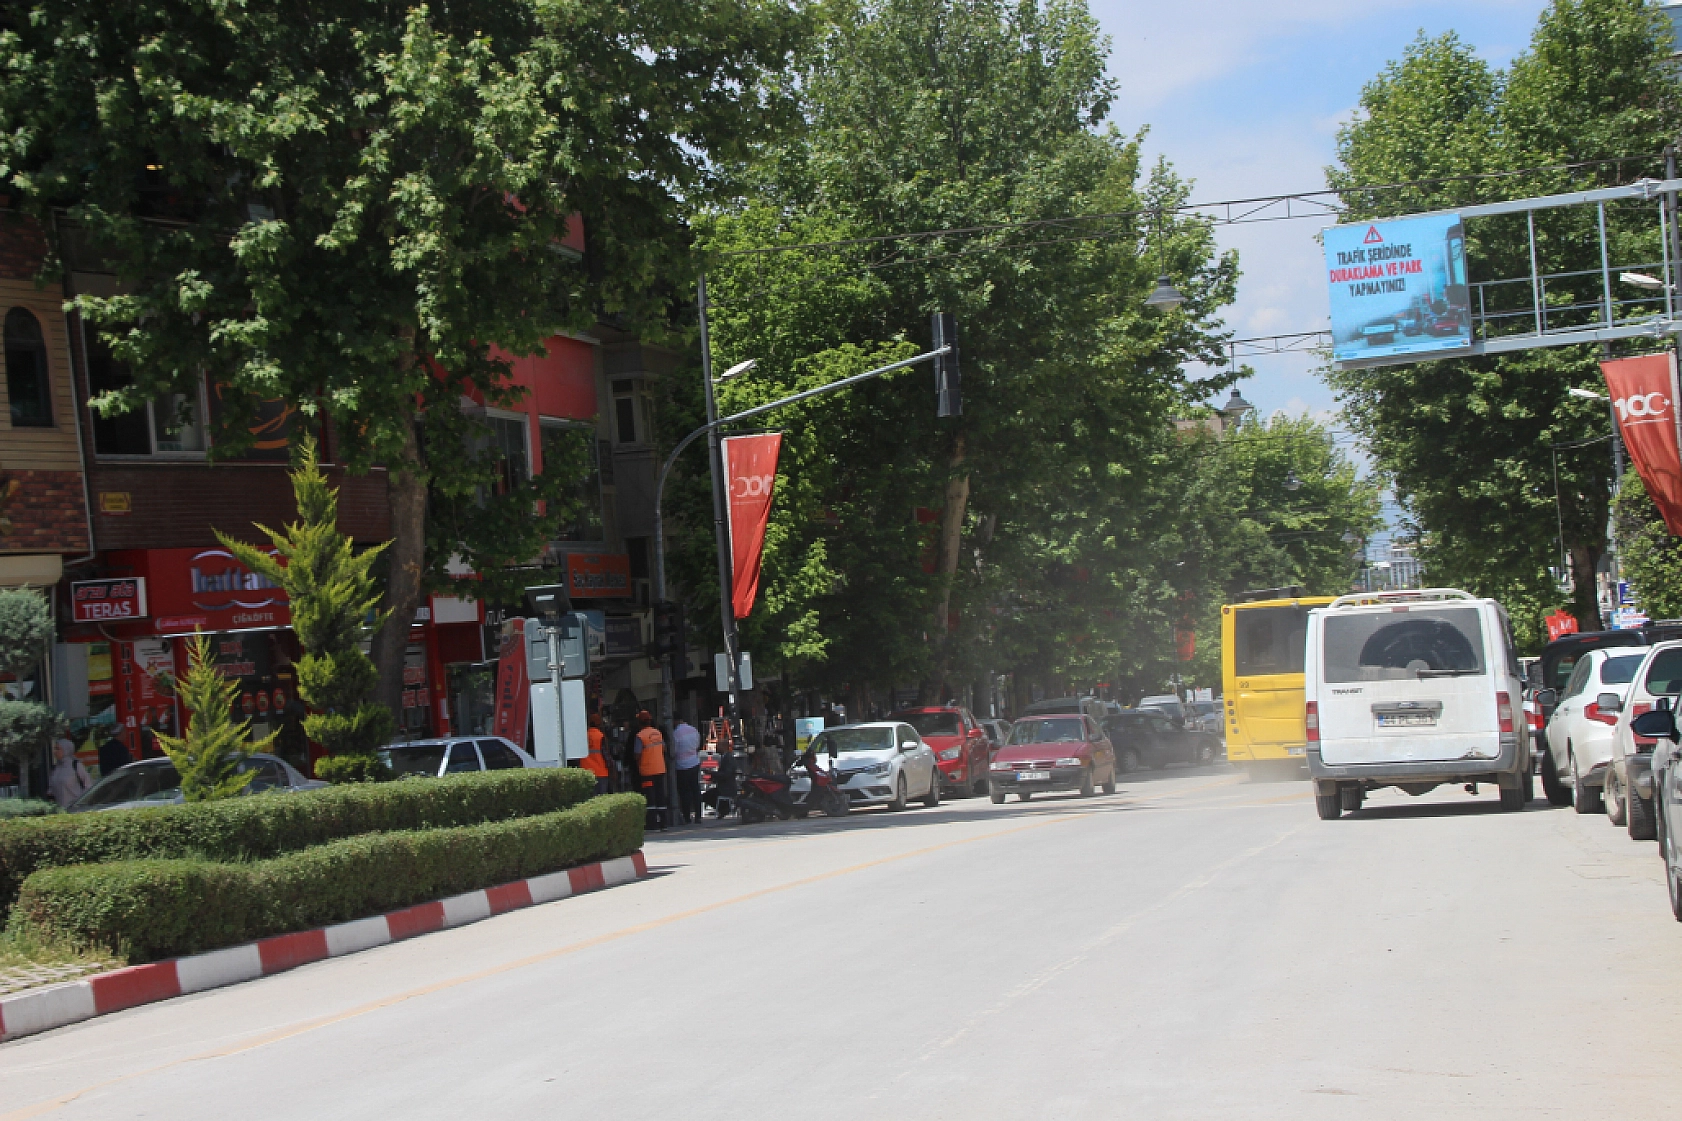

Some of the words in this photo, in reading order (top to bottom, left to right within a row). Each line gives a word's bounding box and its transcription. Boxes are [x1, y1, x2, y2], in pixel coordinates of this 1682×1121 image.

[1336, 247, 1366, 266] TRAFİK
[1367, 242, 1412, 265] ŞERİDİNDE
[1329, 264, 1385, 283] DURAKLAMA
[1385, 262, 1398, 277] VE
[1399, 259, 1423, 275] PARK
[82, 600, 132, 619] TERAS
[1331, 687, 1364, 695] TRANSIT
